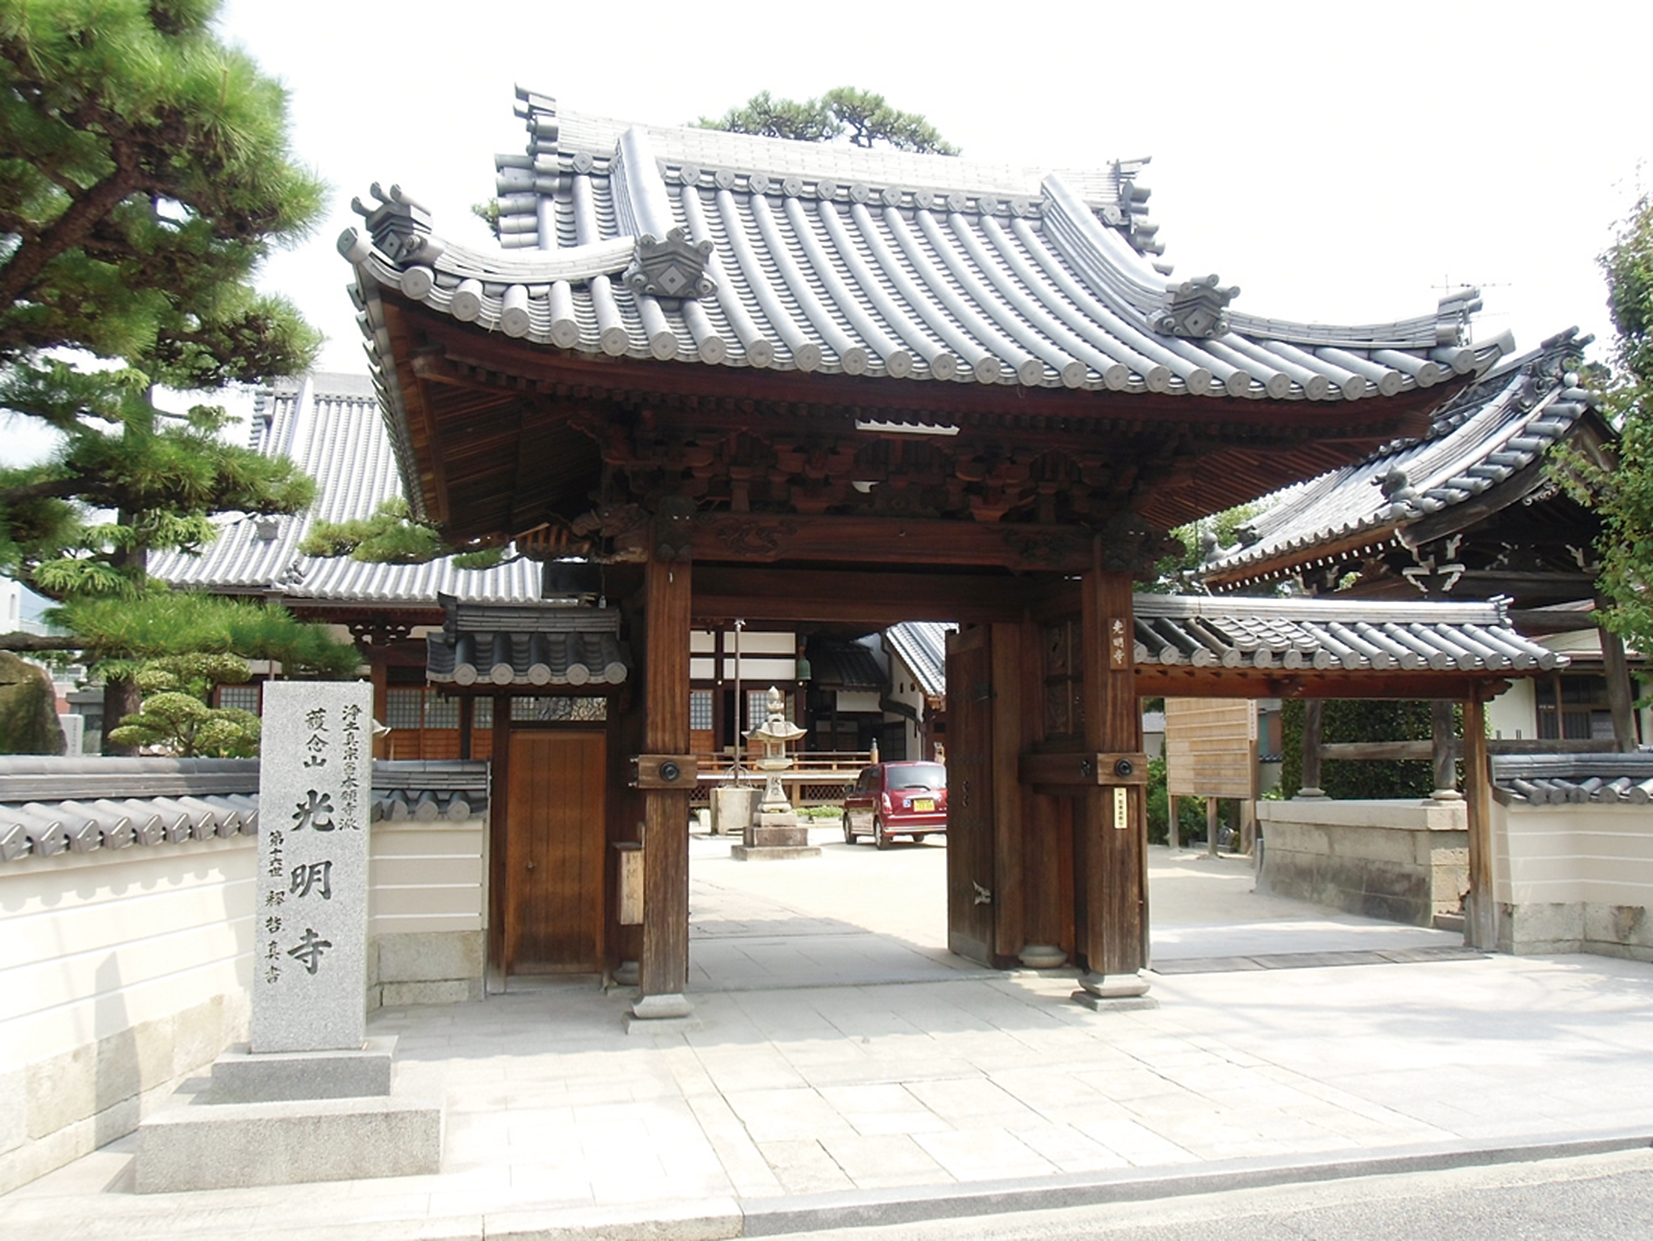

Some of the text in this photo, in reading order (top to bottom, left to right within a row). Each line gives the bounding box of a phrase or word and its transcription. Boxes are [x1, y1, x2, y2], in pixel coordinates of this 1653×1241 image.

[1112, 619, 1125, 665] 光明寺
[267, 829, 286, 878] 第十六世
[286, 788, 336, 976] 光明寺
